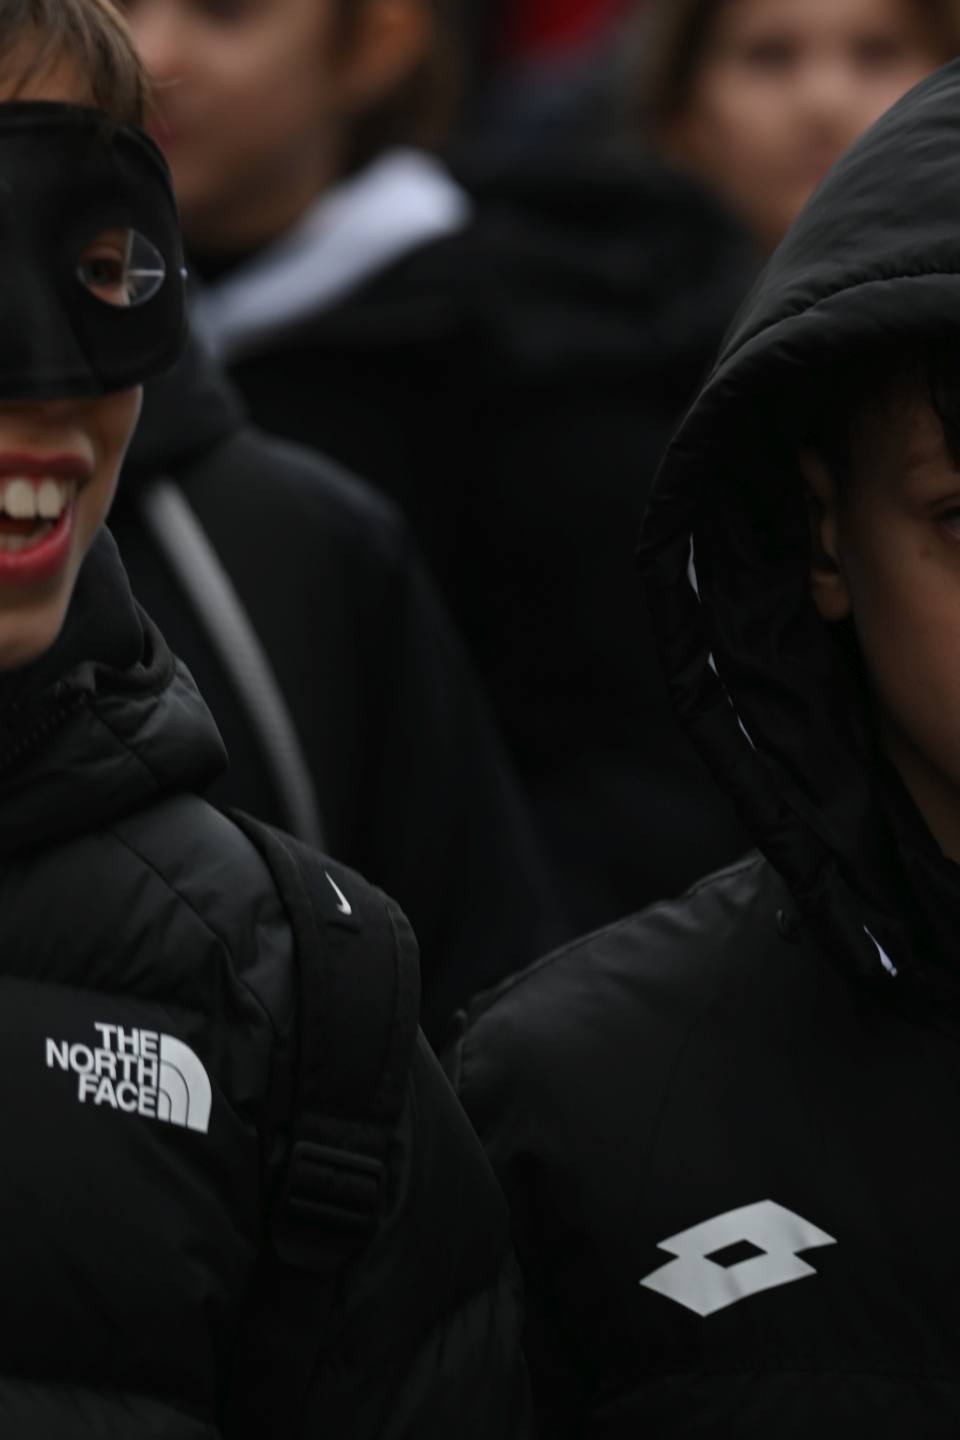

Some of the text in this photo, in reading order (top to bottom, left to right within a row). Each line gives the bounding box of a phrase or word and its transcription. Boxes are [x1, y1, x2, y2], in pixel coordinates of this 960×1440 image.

[46, 1037, 158, 1089] NORTH
[94, 1021, 159, 1060] THE
[78, 1072, 157, 1118] FACE
